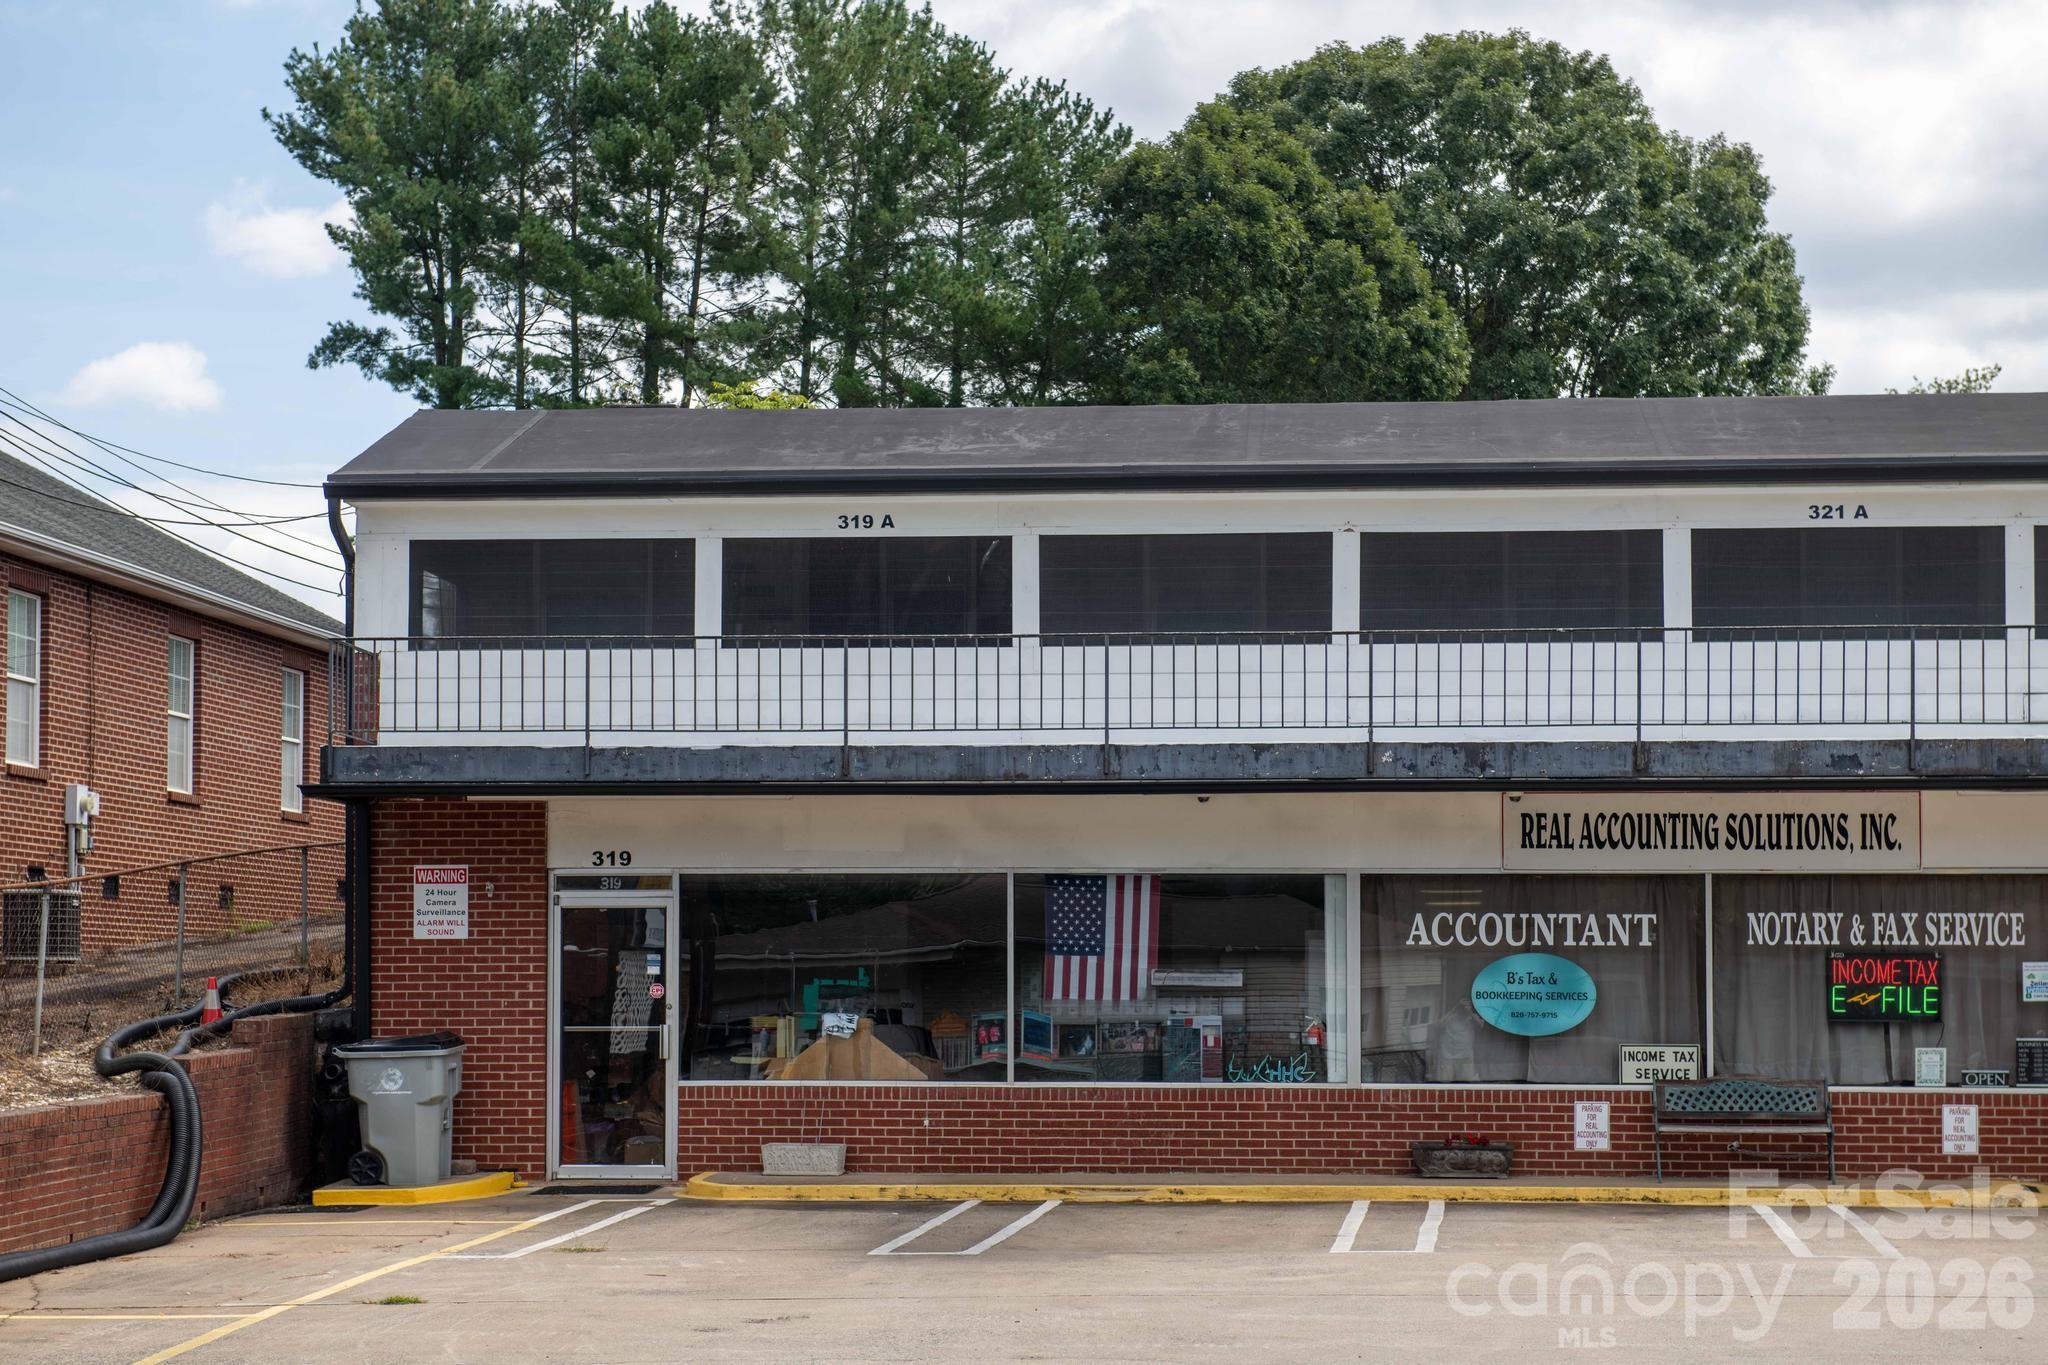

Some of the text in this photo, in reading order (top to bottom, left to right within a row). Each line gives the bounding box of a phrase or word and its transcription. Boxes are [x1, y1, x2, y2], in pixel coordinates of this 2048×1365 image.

[1809, 504, 1869, 520] 321 A
[837, 514, 896, 529] 319 A
[1520, 812, 1902, 854] REAL ACCOUNTING SOLUTIONS, INC.
[591, 850, 632, 866] 319
[416, 869, 466, 883] WARNING
[600, 876, 622, 890] 319
[425, 888, 457, 896] 24 Hour
[416, 908, 466, 916] Surveillance
[416, 919, 466, 927] ALARM WILL
[427, 928, 455, 936] SOUND
[1405, 912, 1657, 946] ACCOUNTANT
[1747, 912, 2026, 946] NOTARY & FAX SERVICE
[1832, 958, 1938, 985] INCOME TAX
[1507, 971, 1558, 985] B's Tax &
[1475, 991, 1588, 1002] BOOKKEEPING SERVICES
[1511, 1011, 1558, 1019] 828-757-9715
[1623, 1050, 1696, 1063] INCOME TAX
[1635, 1068, 1691, 1080] SERVICE
[1965, 1073, 2006, 1085] OPEN
[1949, 1107, 1970, 1115] PARKING
[1587, 1113, 1597, 1121] FOR
[1954, 1116, 1965, 1124] FOR
[1585, 1122, 1598, 1130] REAL
[1953, 1125, 1966, 1133] REAL
[1577, 1130, 1608, 1139] ACCOUNTING
[1945, 1134, 1976, 1142] ACCOUNTING
[1585, 1140, 1598, 1148] ONLY
[1953, 1143, 1966, 1151] ONLY
